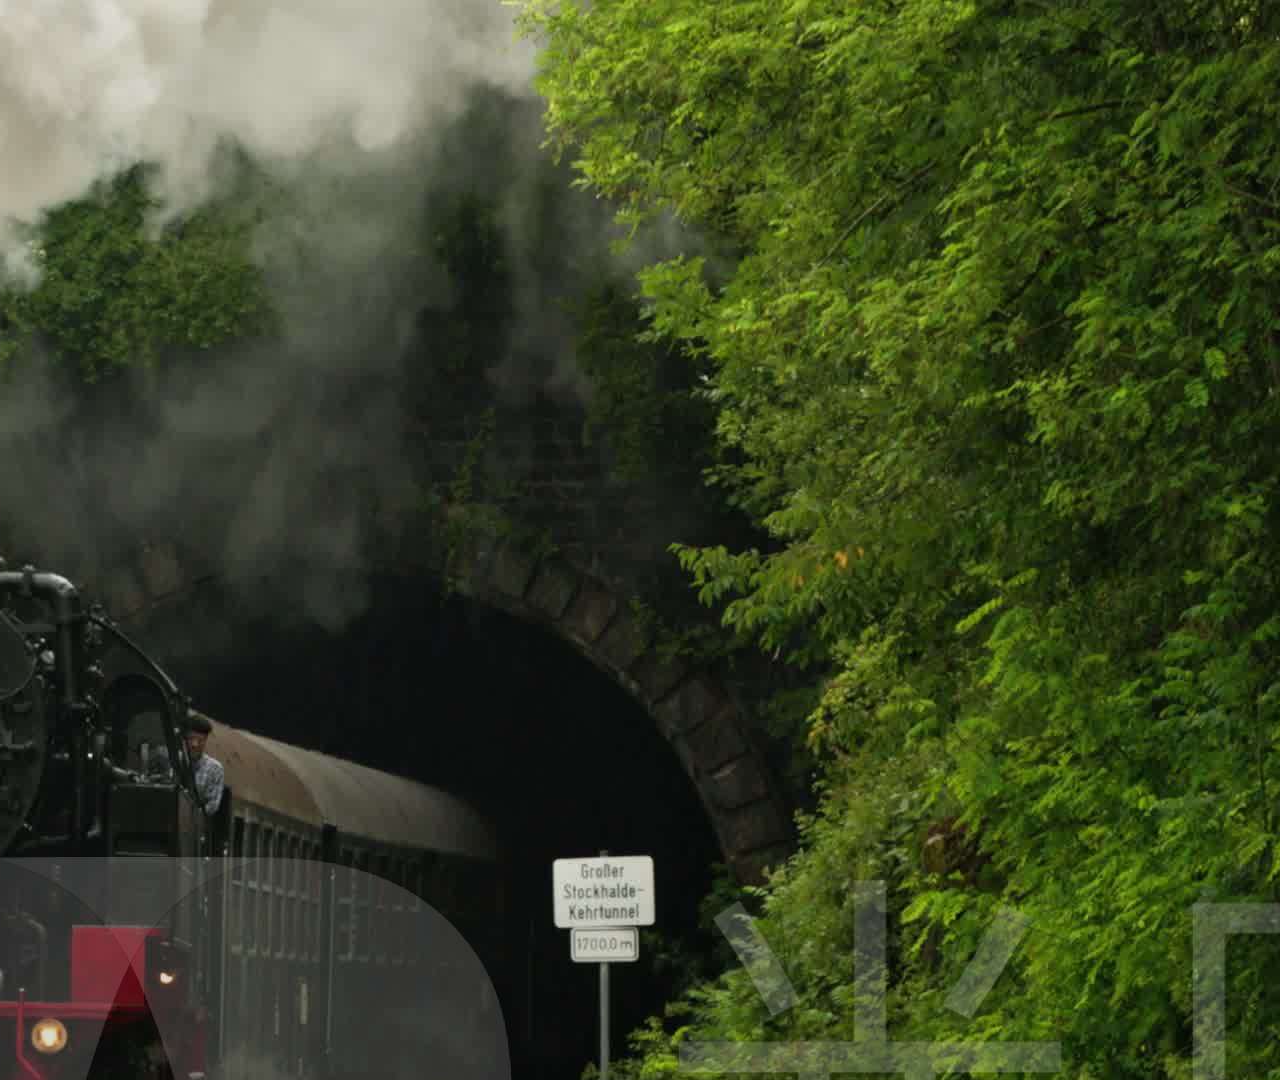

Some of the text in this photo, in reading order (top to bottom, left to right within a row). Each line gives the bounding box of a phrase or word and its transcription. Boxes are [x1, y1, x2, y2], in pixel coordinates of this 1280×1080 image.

[580, 863, 625, 879] Großer
[563, 882, 646, 899] Stockhalde-
[569, 904, 640, 920] Kehrtunnel
[621, 940, 633, 951] m
